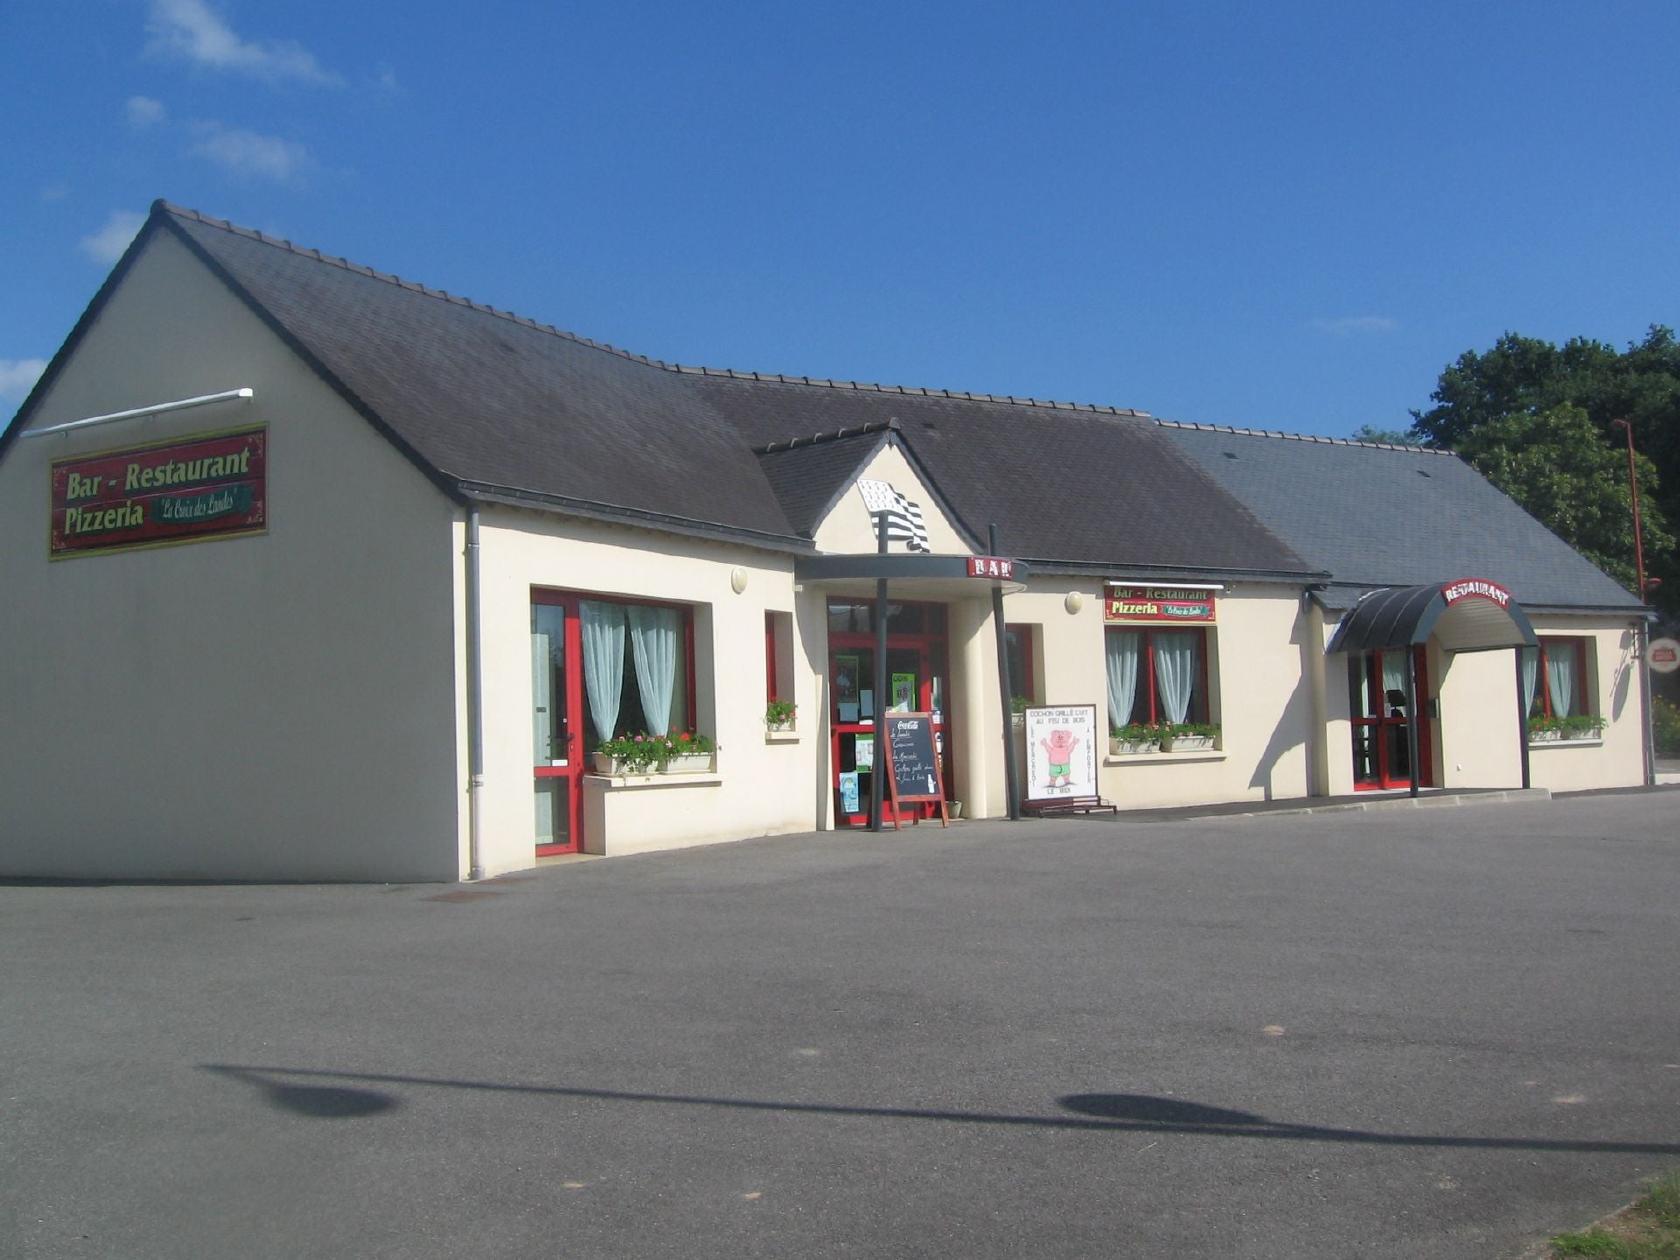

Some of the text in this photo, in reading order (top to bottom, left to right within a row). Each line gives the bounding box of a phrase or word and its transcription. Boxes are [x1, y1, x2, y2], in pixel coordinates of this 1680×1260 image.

[65, 472, 102, 501] Bar
[124, 446, 250, 491] Restaurant
[64, 500, 144, 535] Pizzeria
[974, 559, 1011, 577] BAR
[1113, 586, 1132, 599] Bar
[1146, 587, 1208, 600] Restaurant
[1445, 581, 1509, 605] RESTAURANT
[1112, 601, 1158, 614] Pizzeria
